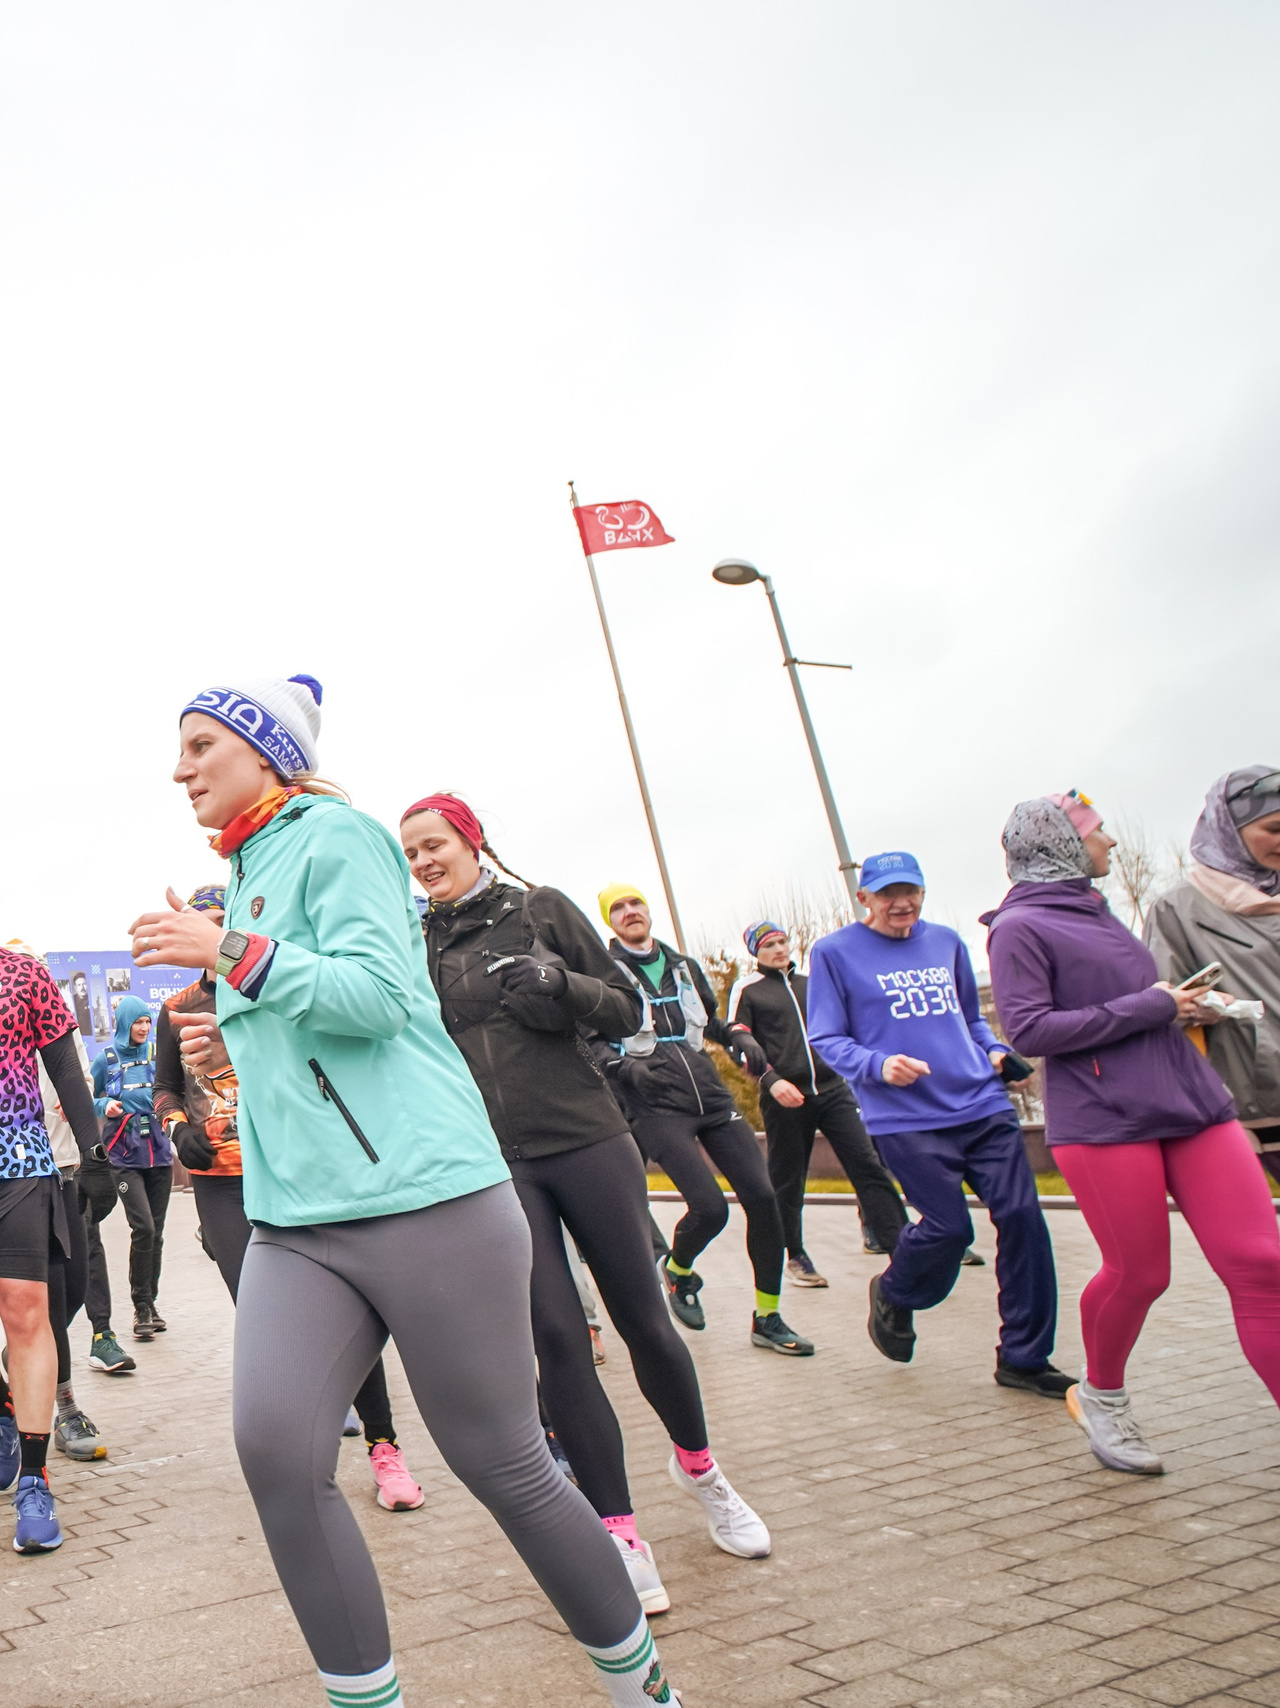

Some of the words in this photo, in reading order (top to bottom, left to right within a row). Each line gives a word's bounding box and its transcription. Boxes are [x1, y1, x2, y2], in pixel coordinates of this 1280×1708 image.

[604, 527, 654, 545] ВДНХ
[486, 956, 516, 974] RUNNING
[876, 966, 952, 990] МОСКВА
[885, 984, 960, 1019] 2030
